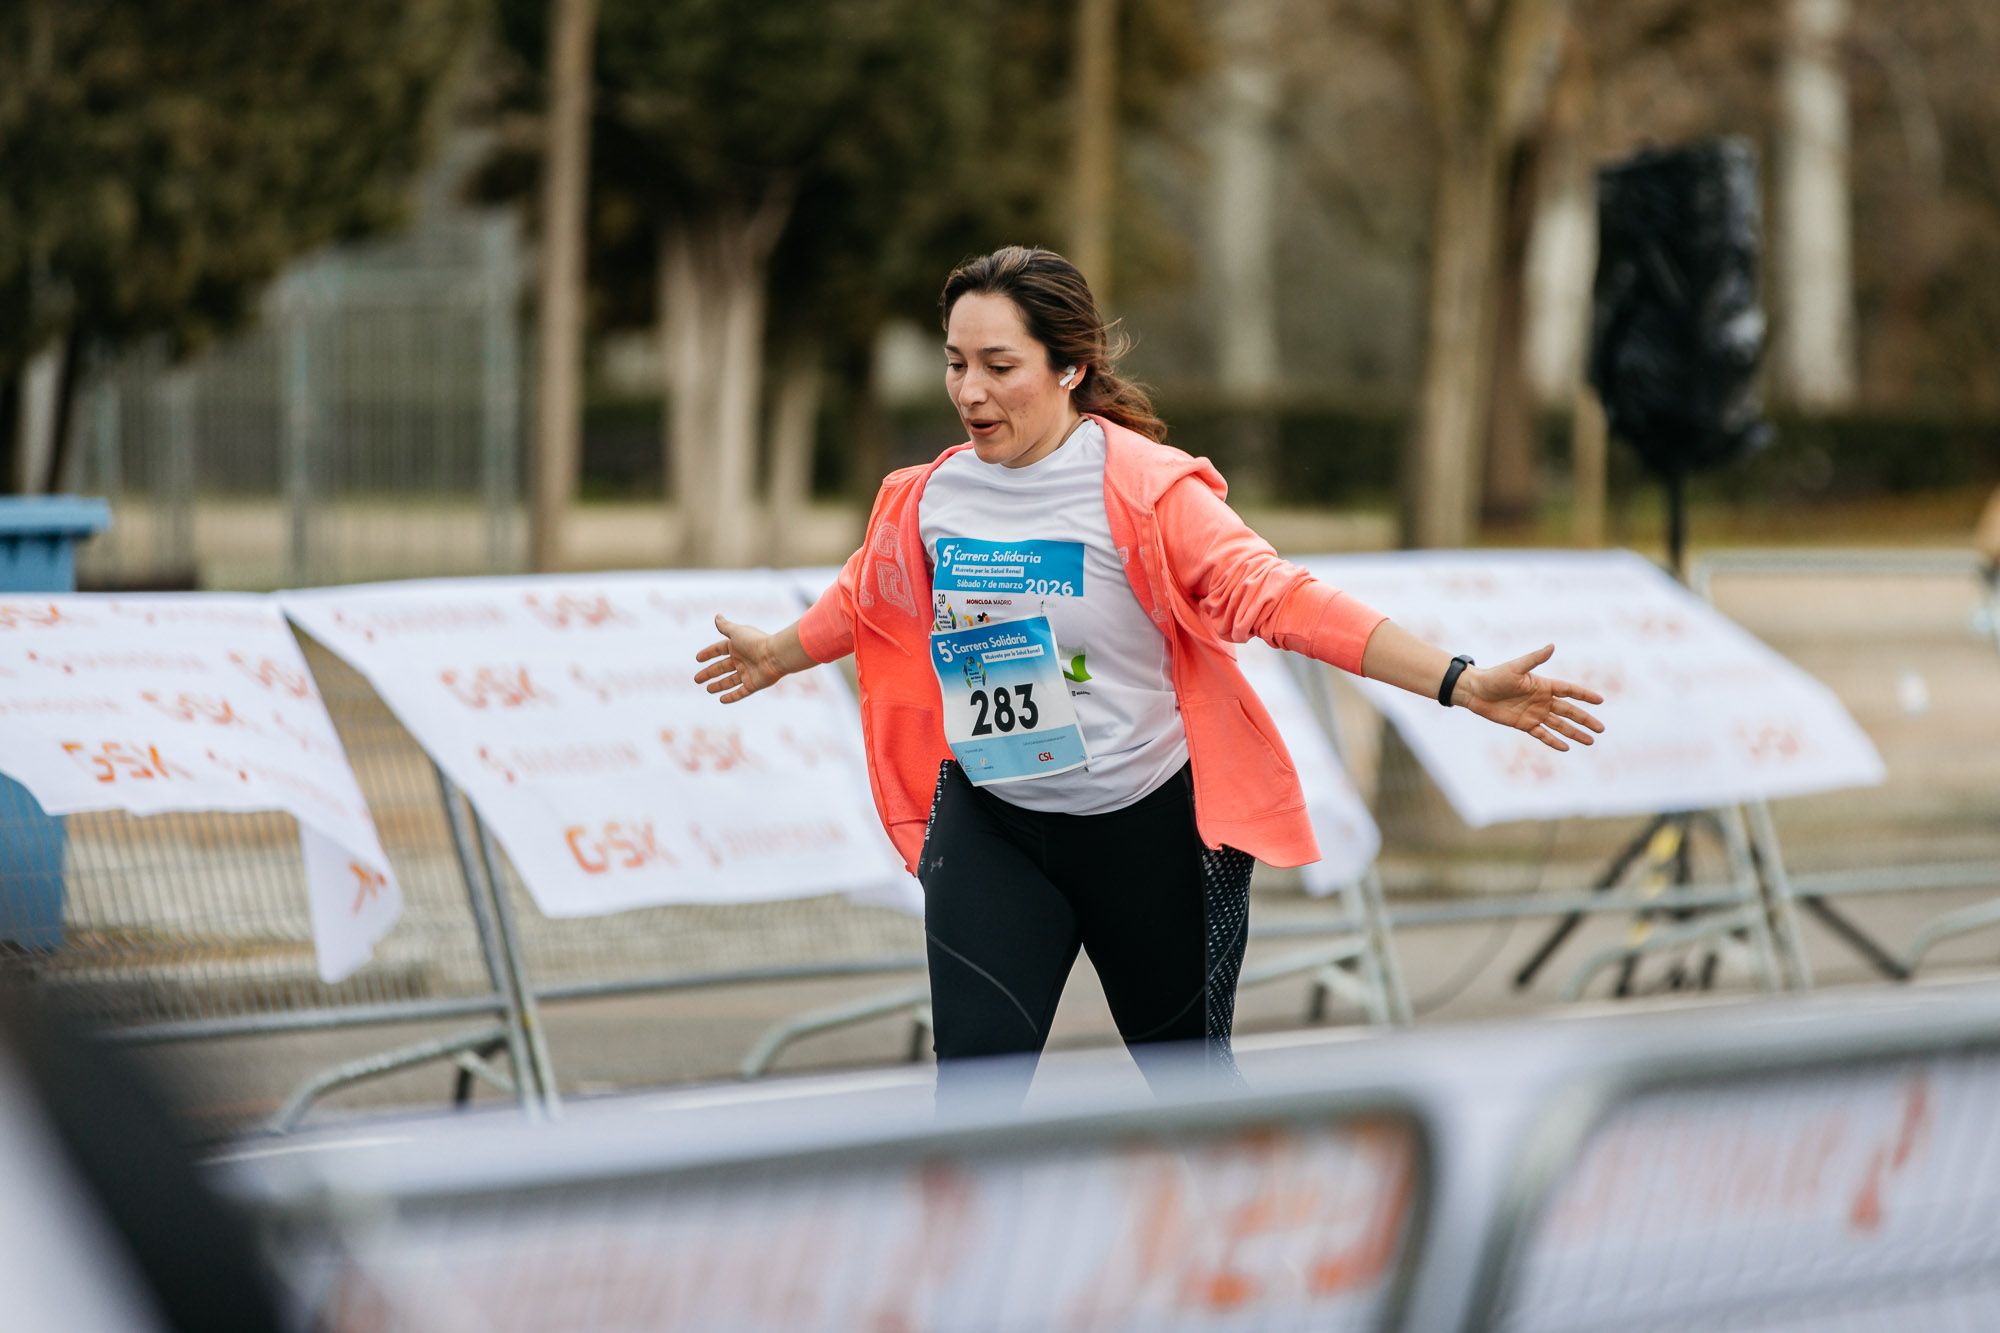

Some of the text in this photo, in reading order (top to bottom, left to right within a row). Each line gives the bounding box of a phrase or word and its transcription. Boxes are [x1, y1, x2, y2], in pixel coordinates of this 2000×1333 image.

[954, 549, 990, 562] Carrera
[990, 550, 1042, 564] Solidaria
[956, 579, 981, 589] Sábado
[982, 579, 988, 589] 7
[988, 580, 997, 589] de
[1025, 578, 1074, 597] 2026
[952, 639, 990, 655] Carrera
[988, 632, 1028, 648] Solidaria
[970, 683, 1039, 737] 283
[1038, 752, 1054, 762] CSL
